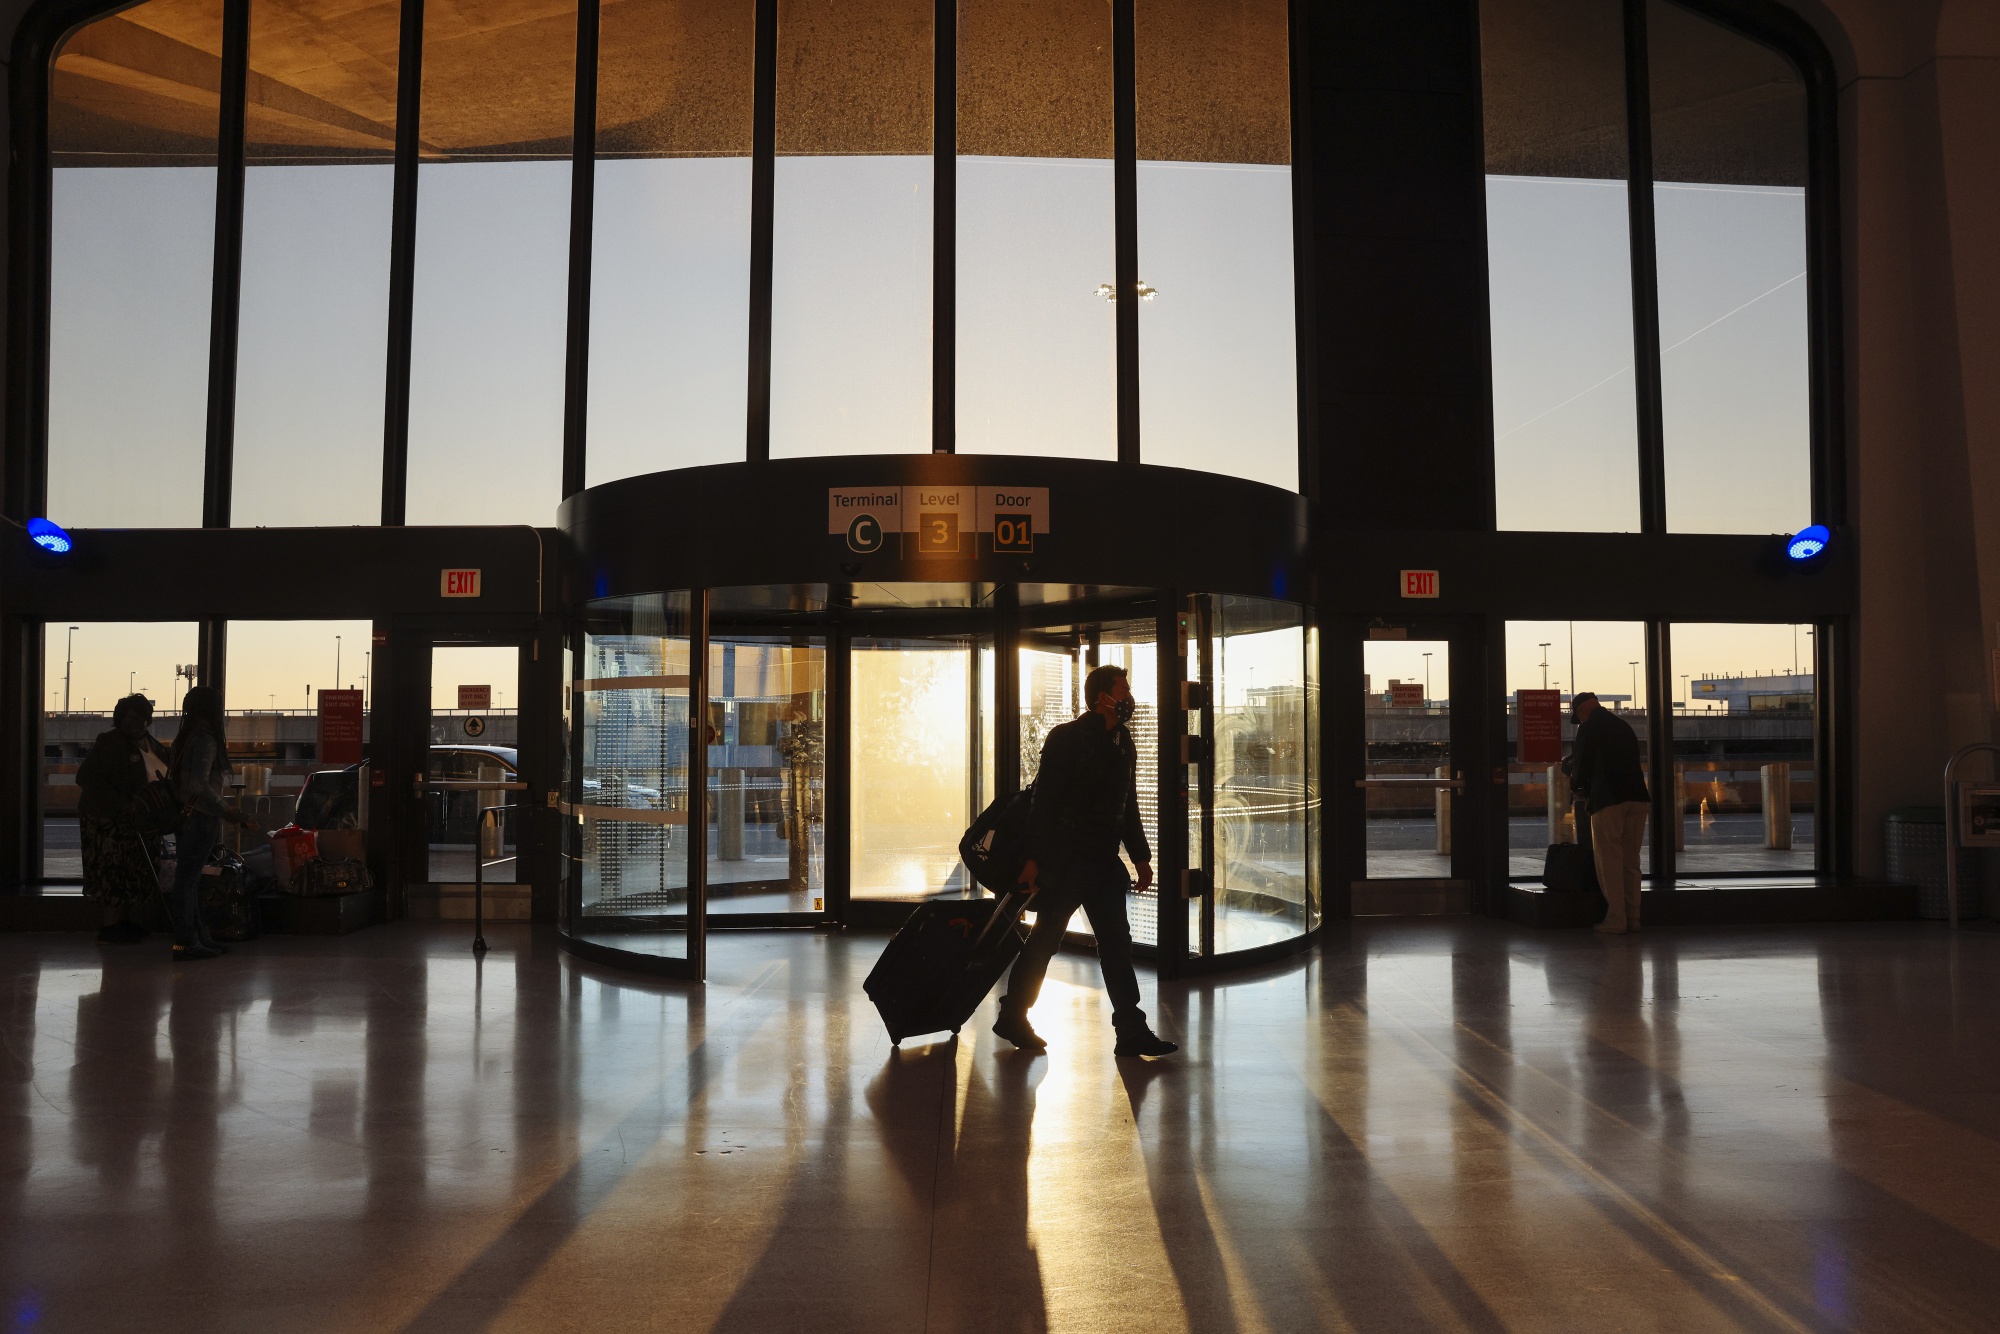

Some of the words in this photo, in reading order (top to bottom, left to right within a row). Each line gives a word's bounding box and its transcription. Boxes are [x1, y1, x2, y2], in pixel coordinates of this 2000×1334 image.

[833, 493, 898, 507] Terminal
[920, 493, 960, 506] Level
[995, 494, 1032, 507] Door
[855, 520, 872, 545] C
[931, 520, 949, 545] 3
[996, 520, 1031, 545] 01
[448, 571, 477, 594] EXIT
[1407, 572, 1435, 595] EXIT
